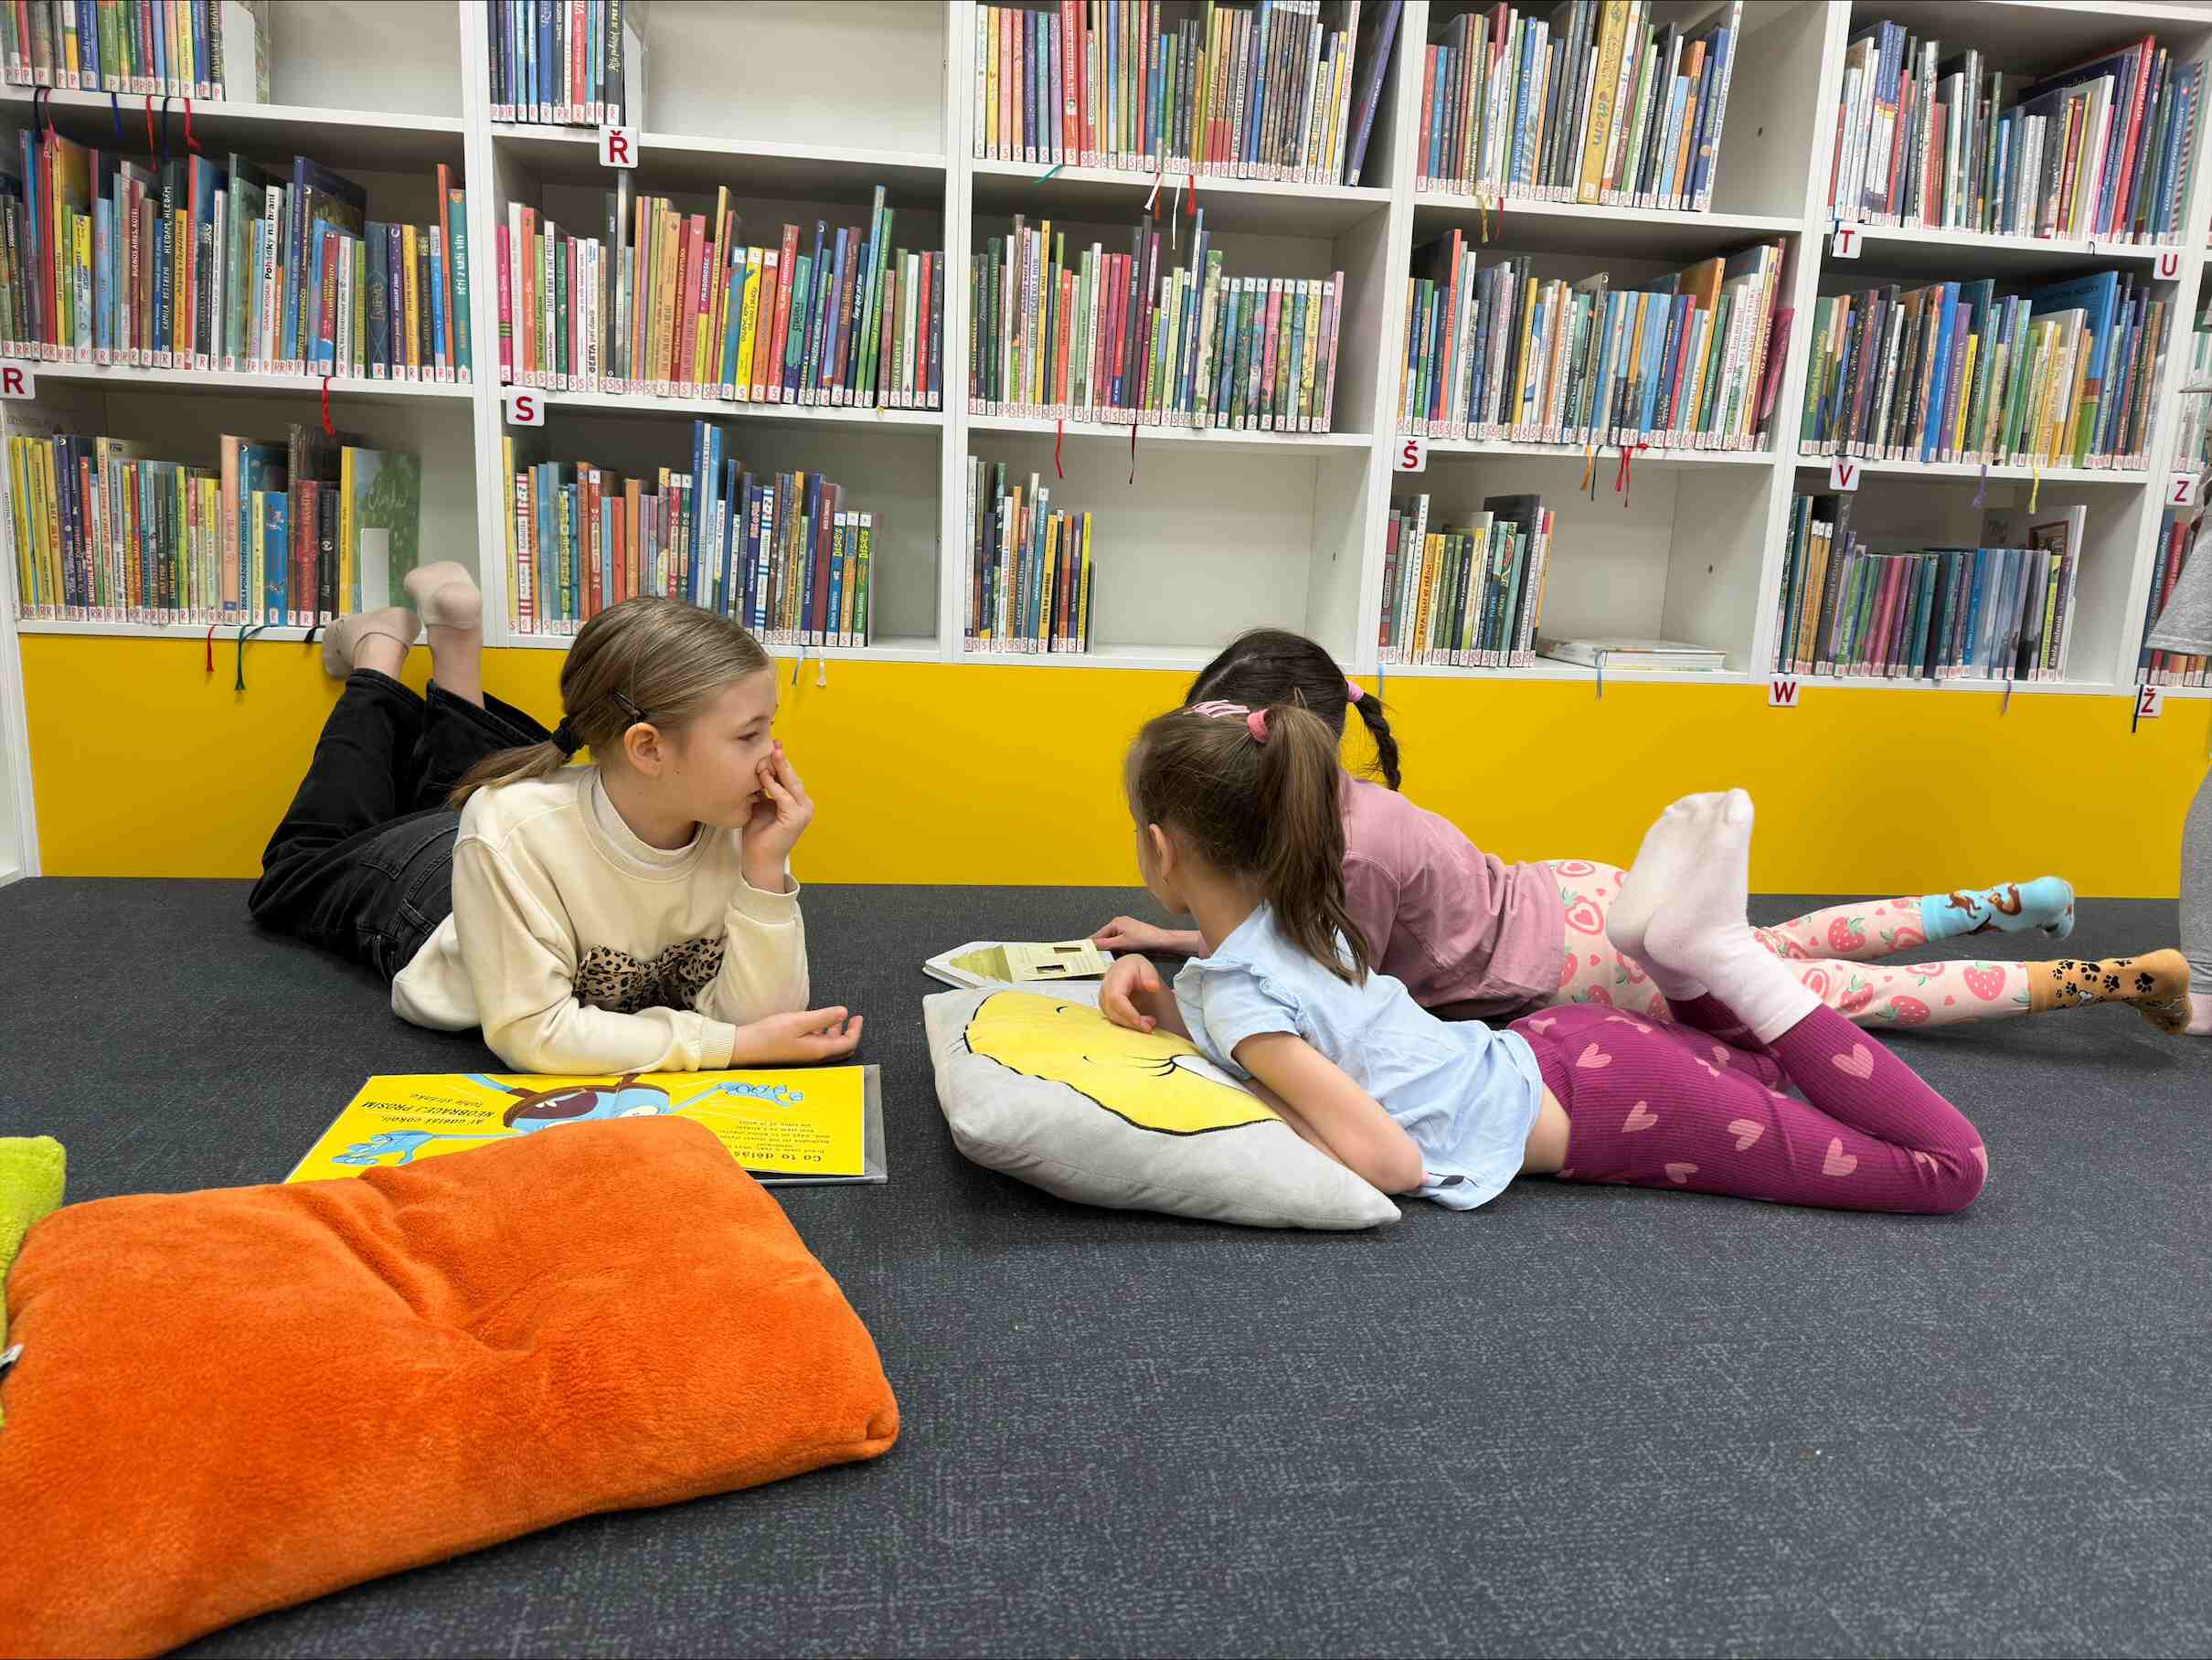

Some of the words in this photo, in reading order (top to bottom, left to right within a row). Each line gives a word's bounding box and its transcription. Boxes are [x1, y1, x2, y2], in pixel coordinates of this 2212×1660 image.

[610, 132, 629, 164] Ř
[265, 194, 274, 220] hraní
[1841, 230, 1855, 253] T
[264, 239, 275, 279] Pohádky
[2163, 254, 2178, 277] U
[3, 368, 25, 394] R
[516, 396, 535, 421] S
[1402, 442, 1419, 469] Š
[1837, 465, 1853, 486] V
[2175, 481, 2188, 502] Z
[1774, 682, 1796, 703] W
[2142, 688, 2154, 713] Ž
[418, 1106, 495, 1118] NEOBRACEJ
